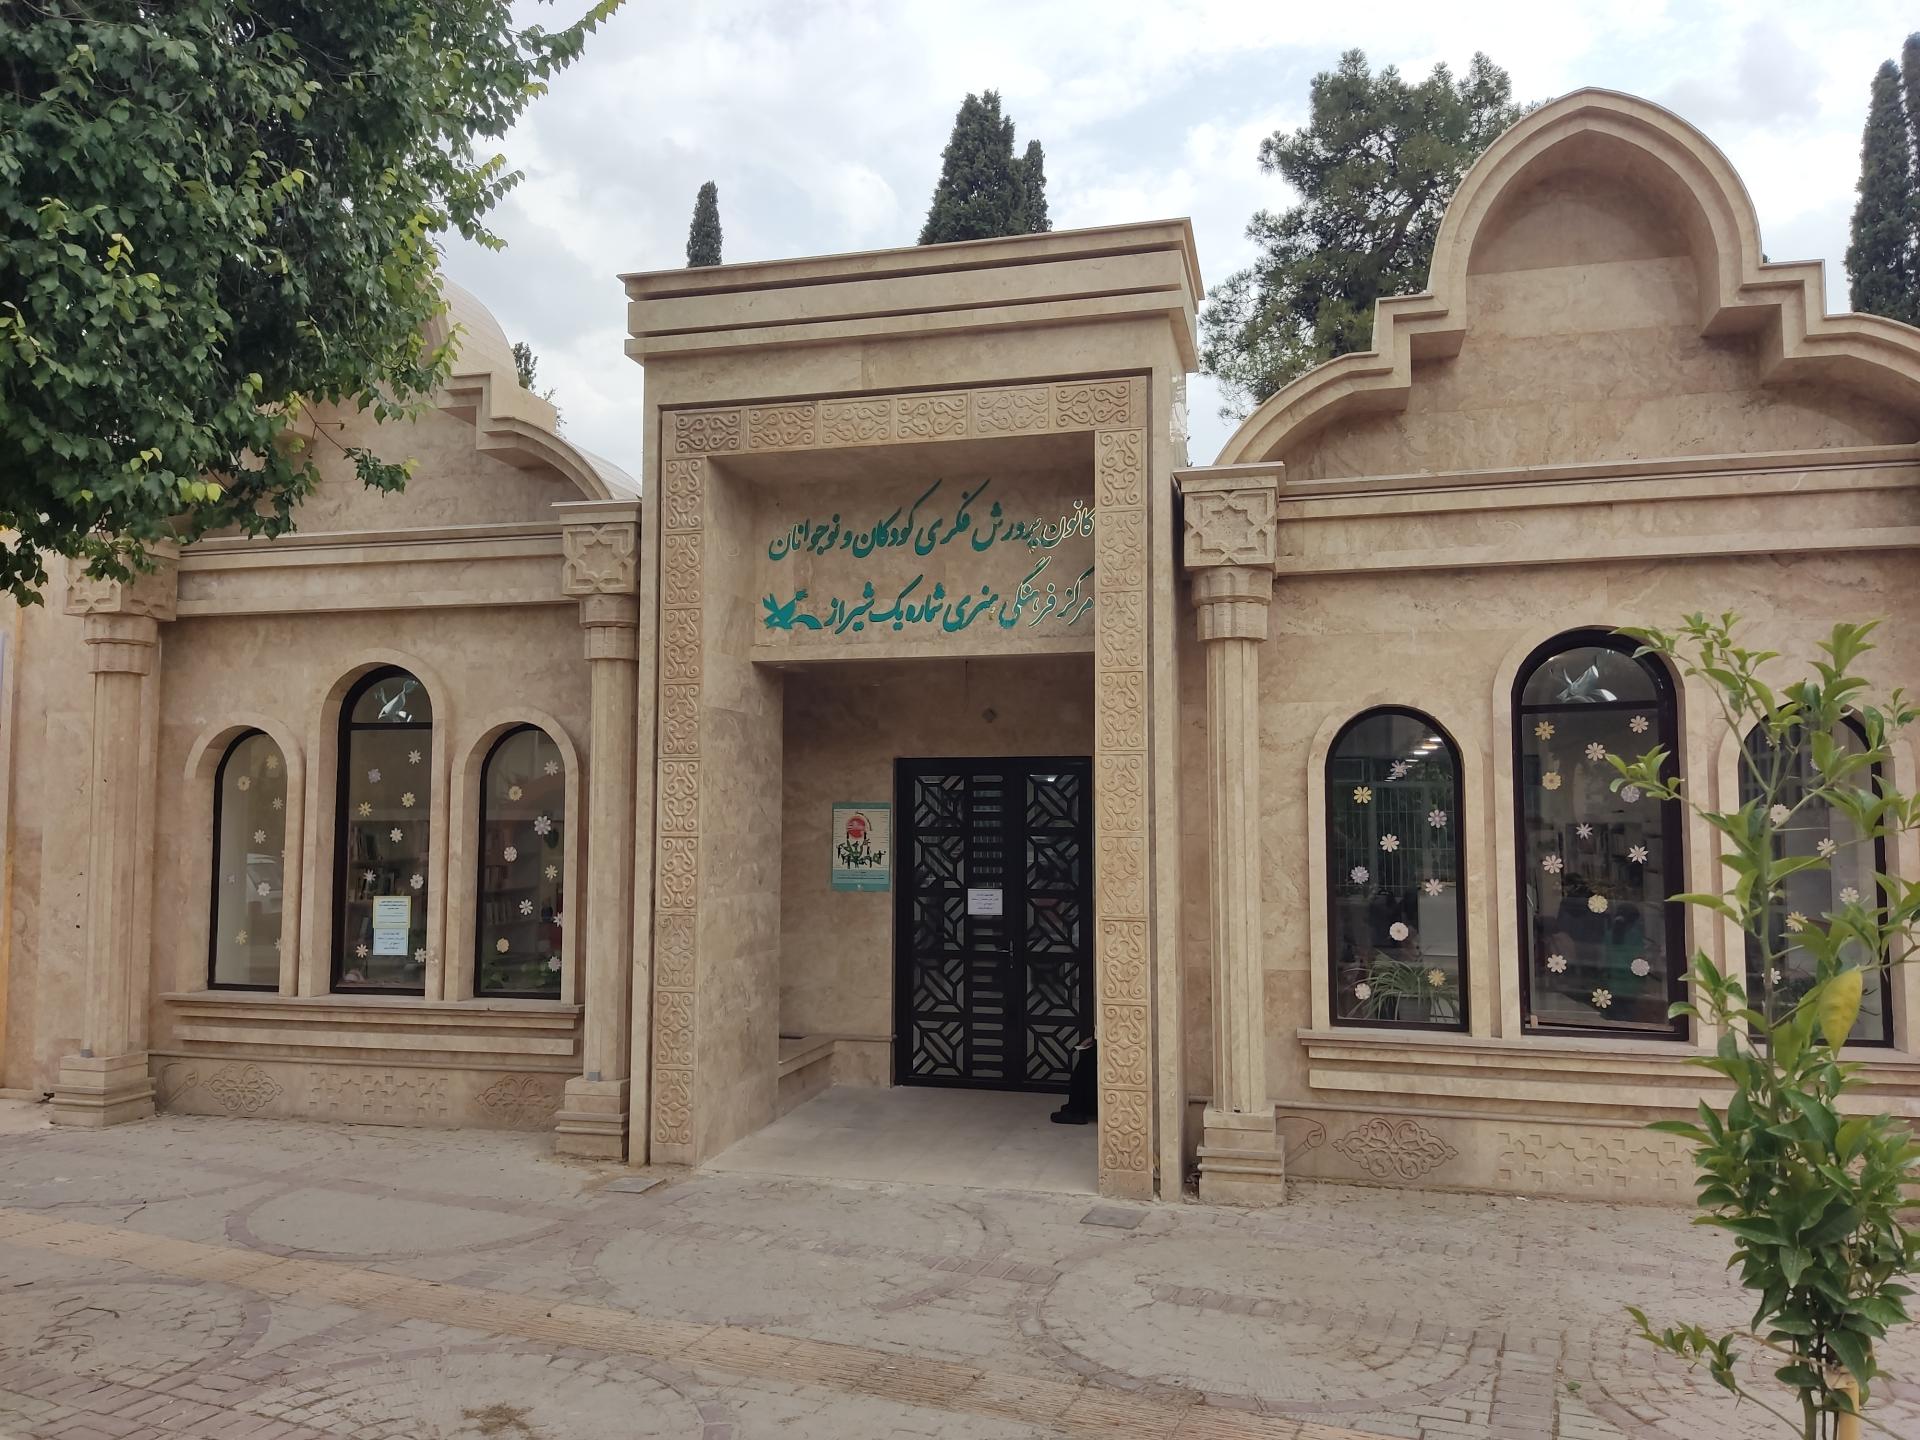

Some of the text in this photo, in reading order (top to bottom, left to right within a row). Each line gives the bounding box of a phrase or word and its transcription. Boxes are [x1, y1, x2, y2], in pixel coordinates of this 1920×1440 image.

[768, 478, 1095, 561] کانون پرورش فکری کودکان و نوجوانان
[824, 555, 1095, 635] مرکز فرهنگی هنری شماره یک شیراز
